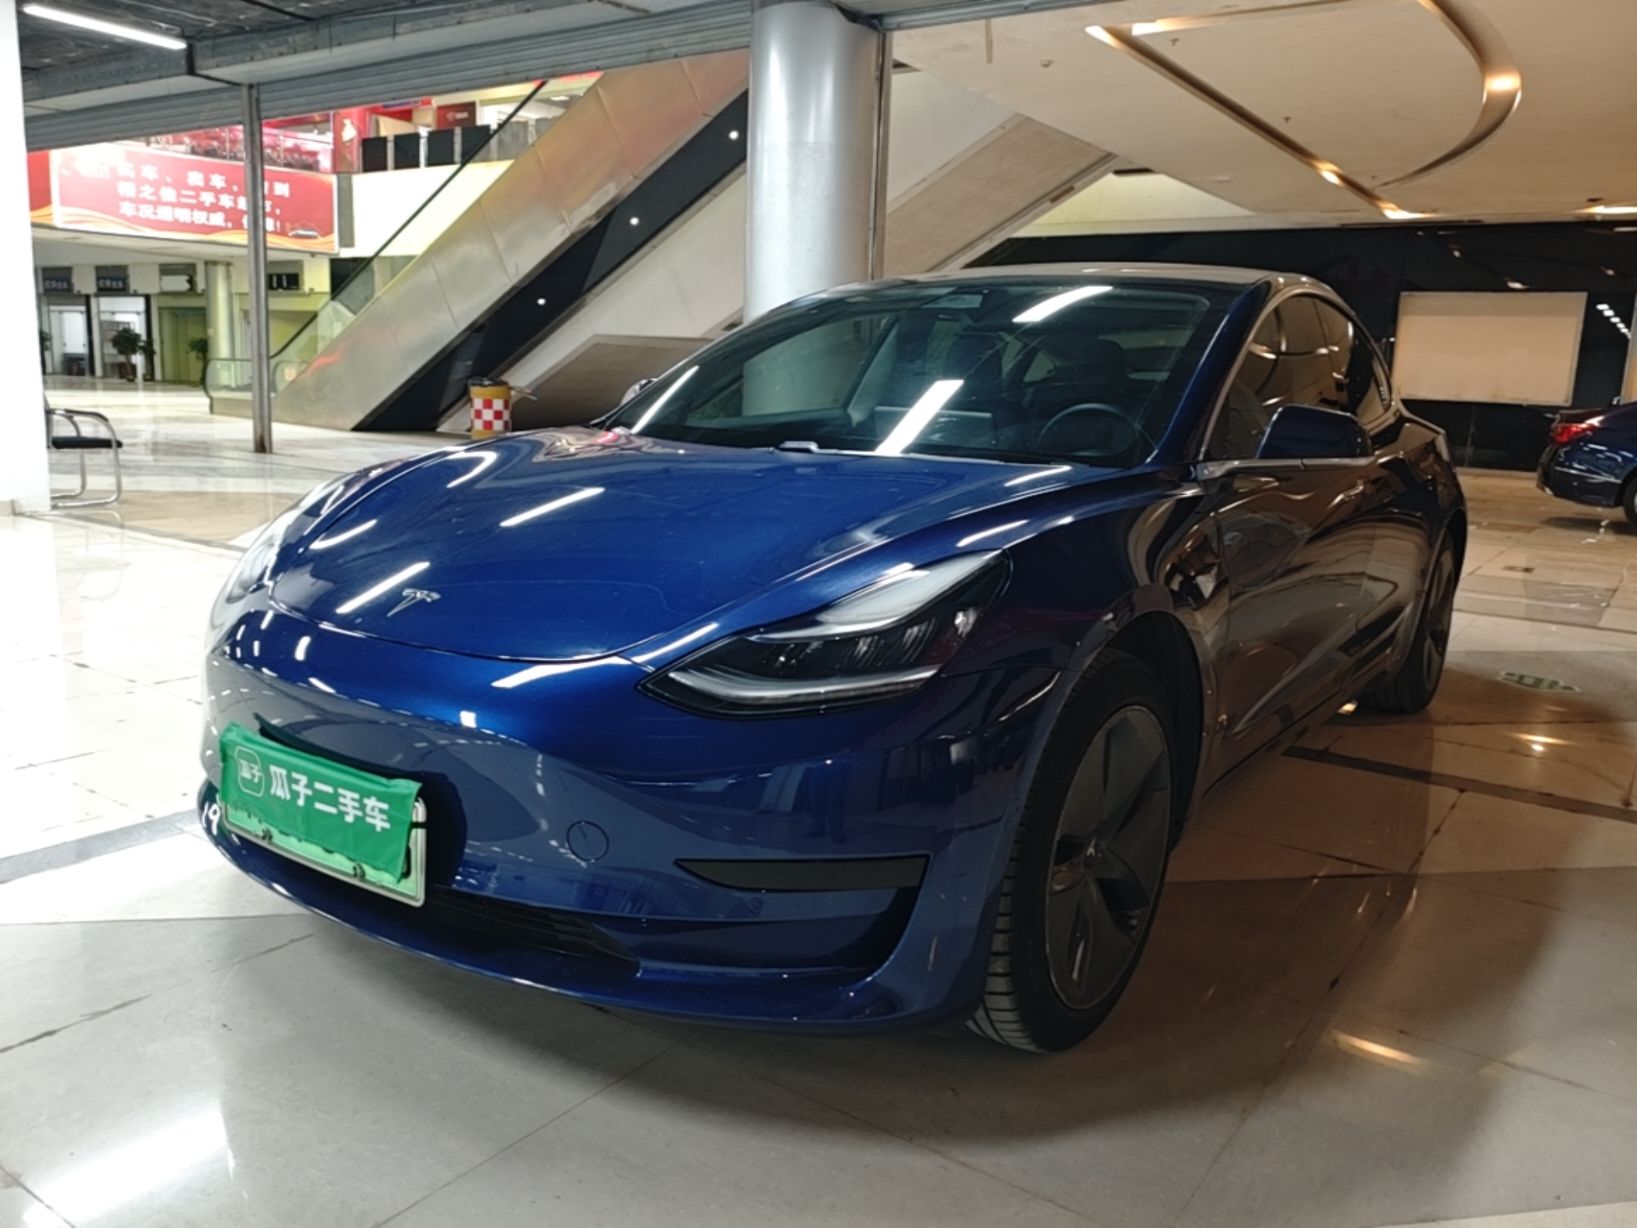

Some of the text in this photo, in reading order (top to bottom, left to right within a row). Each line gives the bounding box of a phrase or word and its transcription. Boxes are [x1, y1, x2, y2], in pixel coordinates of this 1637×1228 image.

[269, 765, 391, 832] 瓜子二手车
